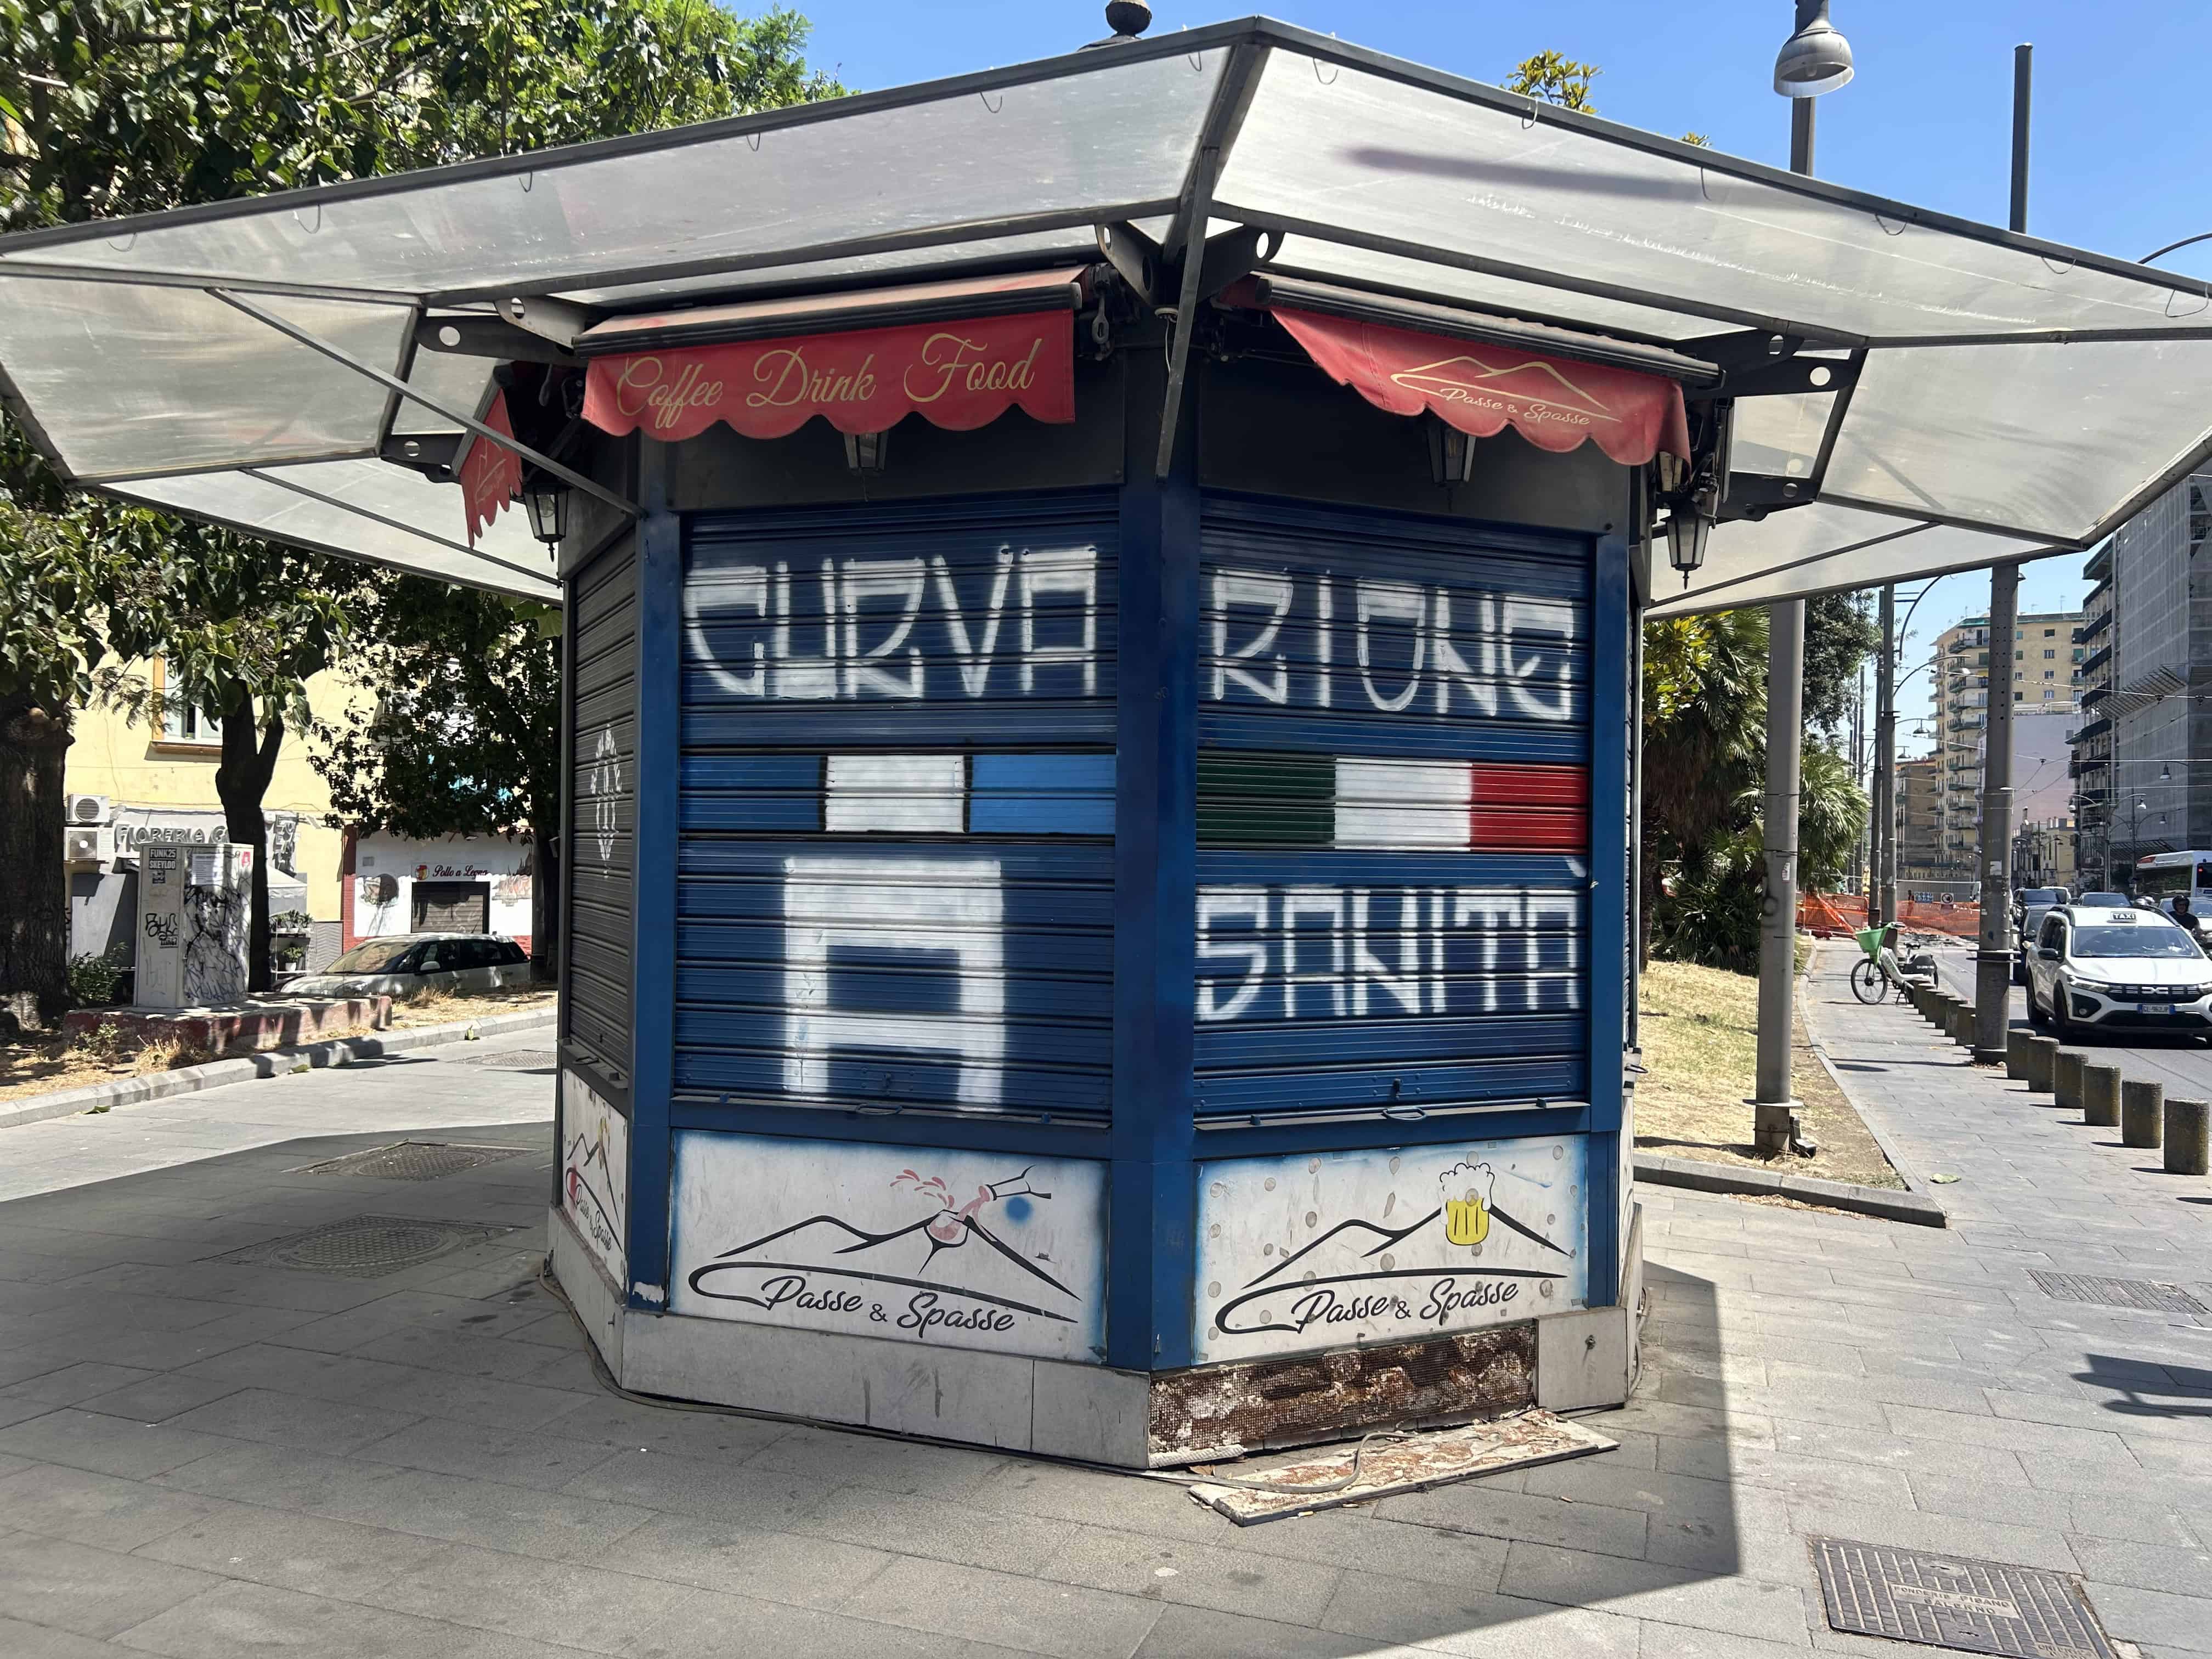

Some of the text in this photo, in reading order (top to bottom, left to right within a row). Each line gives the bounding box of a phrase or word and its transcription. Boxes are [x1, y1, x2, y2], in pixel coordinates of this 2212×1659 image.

[617, 332, 1042, 429] Coffee Drink Food
[1440, 388, 1590, 425] Passe & Spasse
[684, 544, 1097, 700] CURVA
[1212, 567, 1574, 720] RIONE
[150, 849, 176, 857] FUNK25
[432, 865, 454, 877] Pollo
[594, 1210, 611, 1251] Spasse
[761, 1275, 1015, 1338] Passe & Spasse
[1291, 1277, 1519, 1334] Passe & Spasse
[1923, 1598, 1996, 1615] SALERNO
